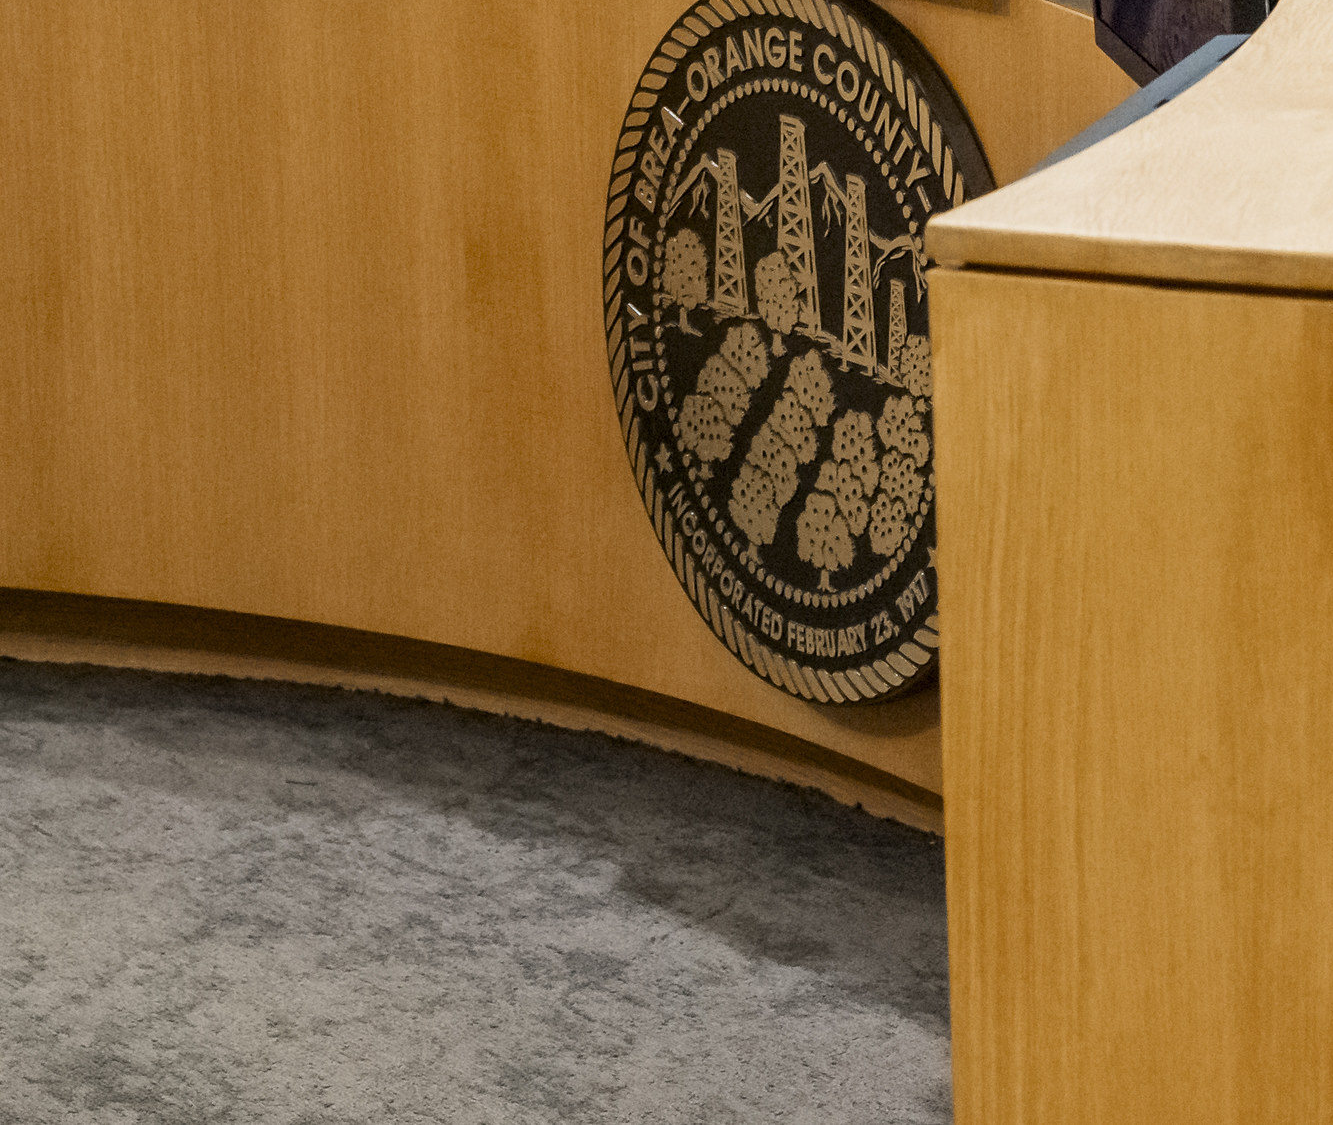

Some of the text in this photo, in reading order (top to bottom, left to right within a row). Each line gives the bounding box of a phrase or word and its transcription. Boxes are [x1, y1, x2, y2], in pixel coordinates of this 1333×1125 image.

[626, 216, 653, 287] OF
[627, 303, 659, 413] CITY
[668, 481, 784, 641] INCORPORATED
[787, 621, 868, 658] FEBRUARY
[895, 569, 930, 623] 1917
